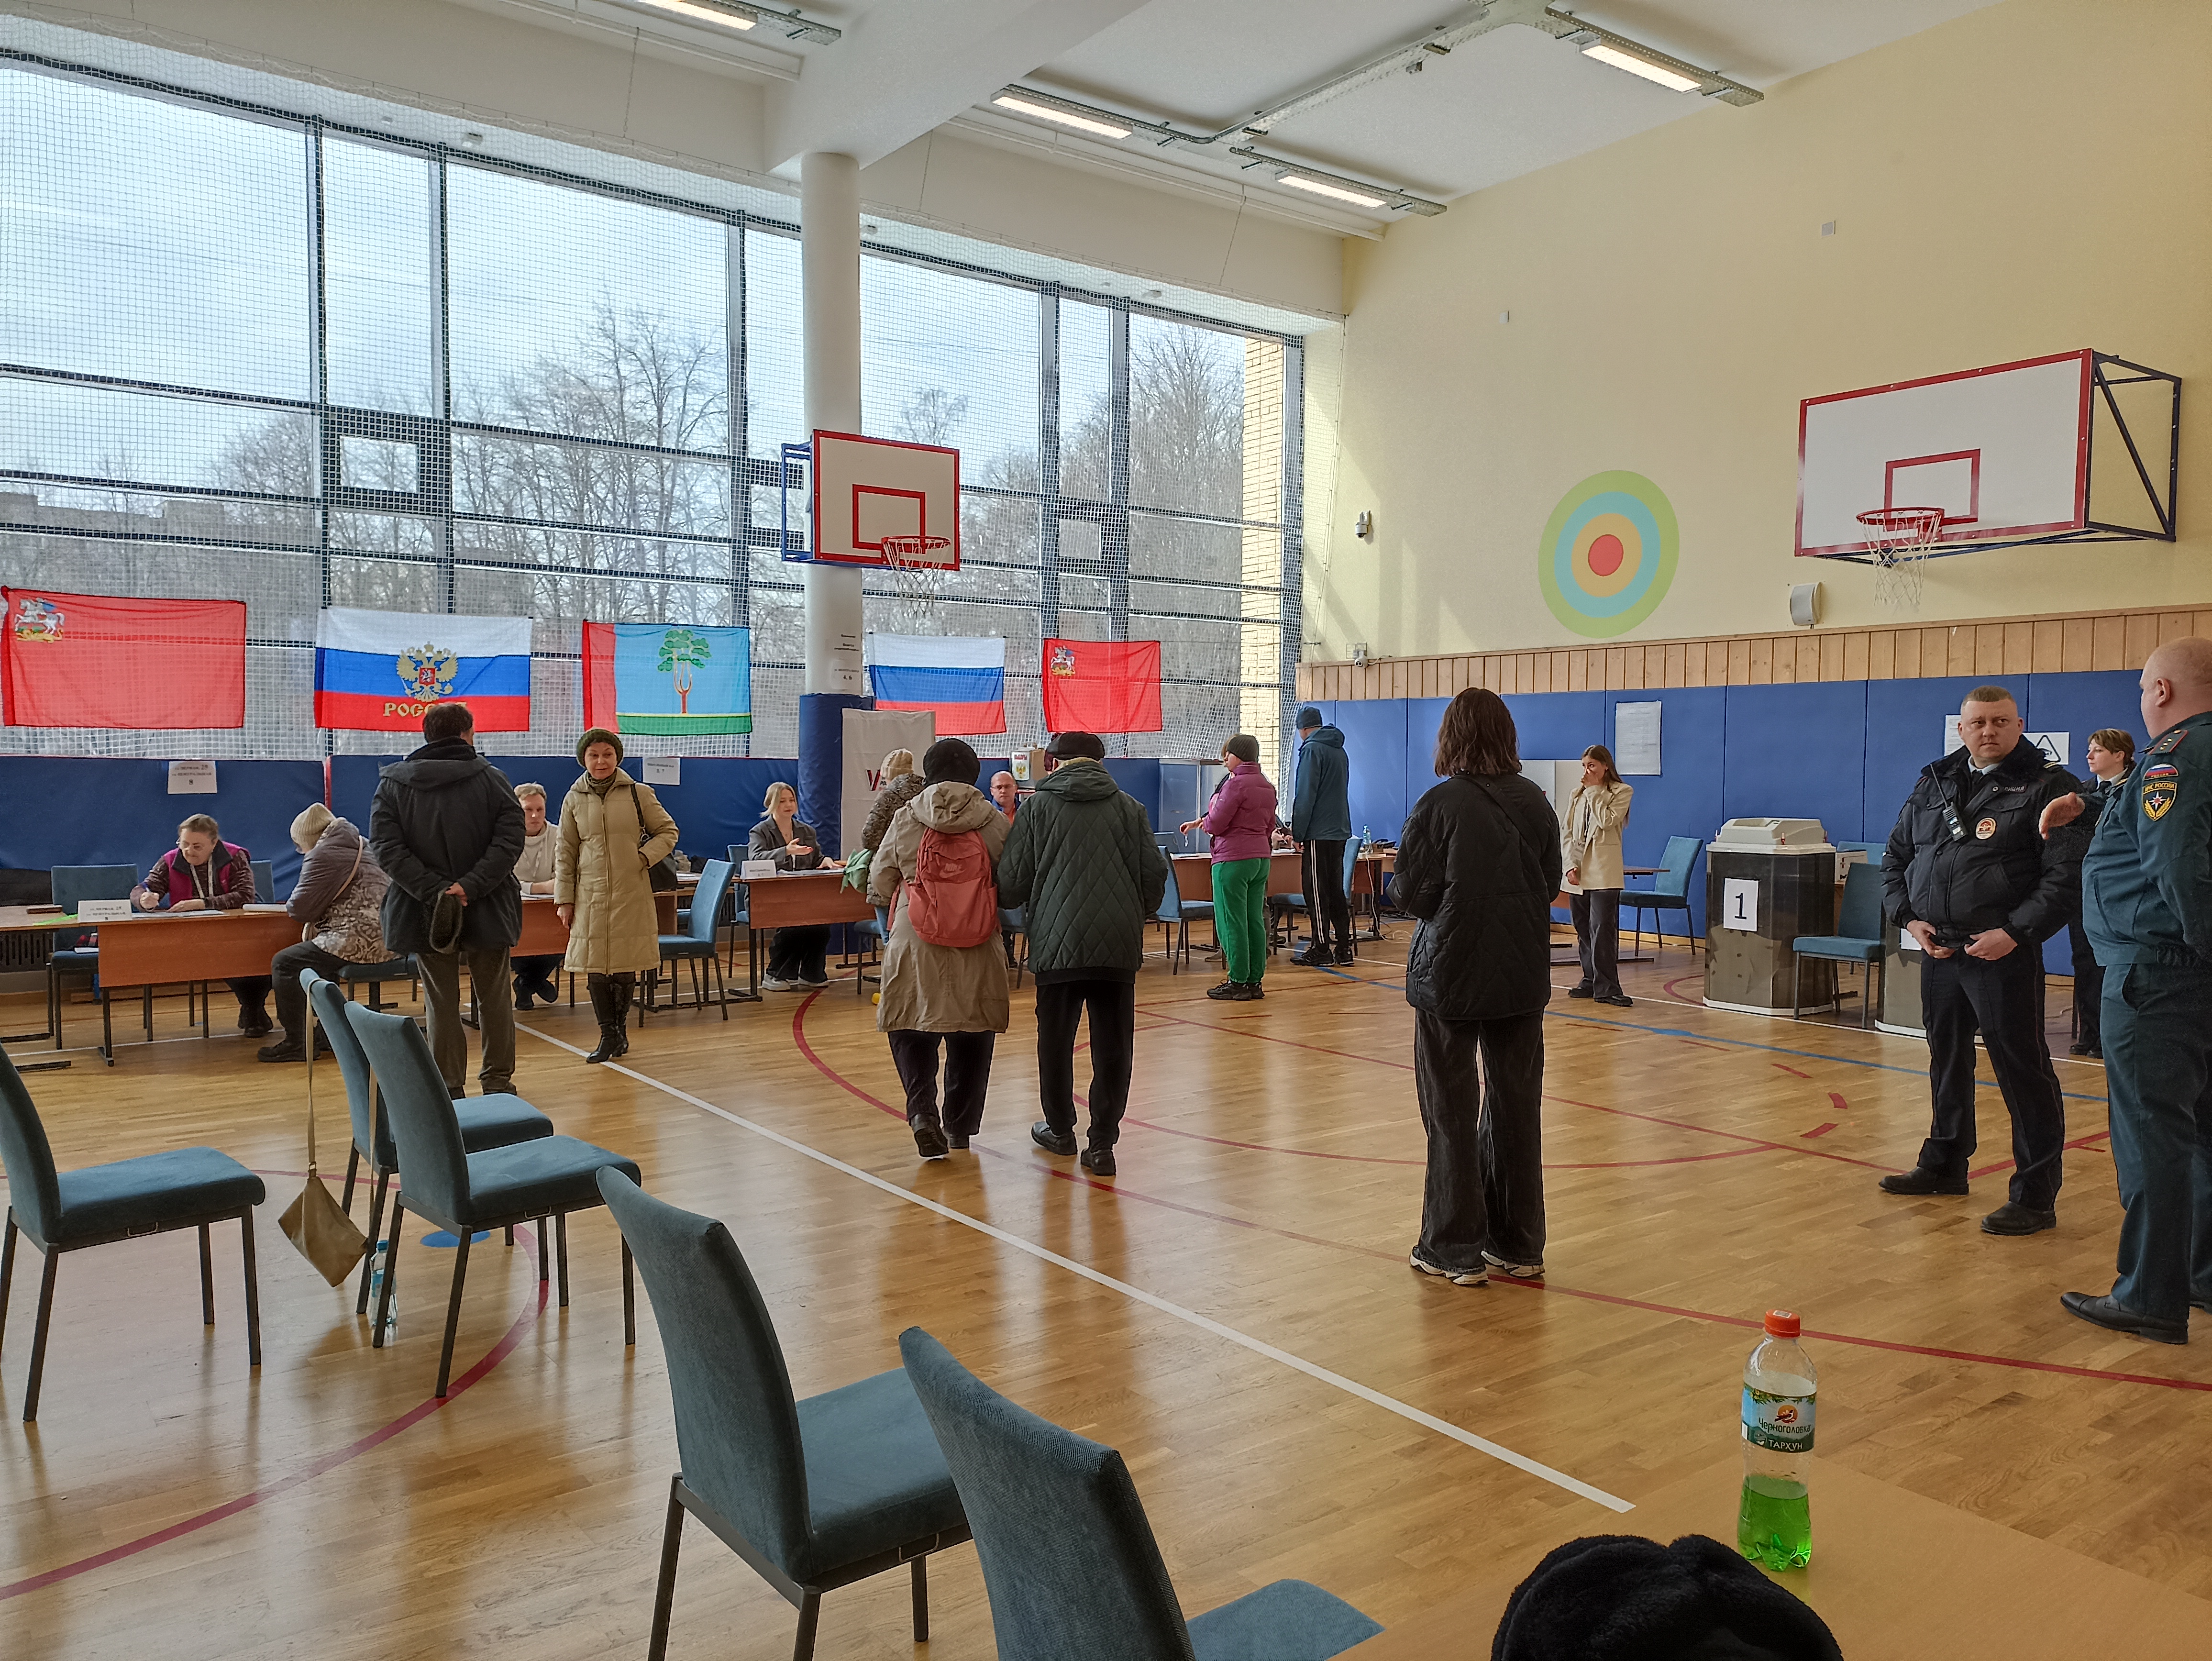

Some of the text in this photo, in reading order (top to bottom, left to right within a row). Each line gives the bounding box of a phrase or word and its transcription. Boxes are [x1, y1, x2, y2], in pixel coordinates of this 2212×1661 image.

[1735, 893, 1747, 919] 1
[1759, 1417, 1811, 1433] Черноголовка
[1768, 1439, 1803, 1451] ТАРХУН
